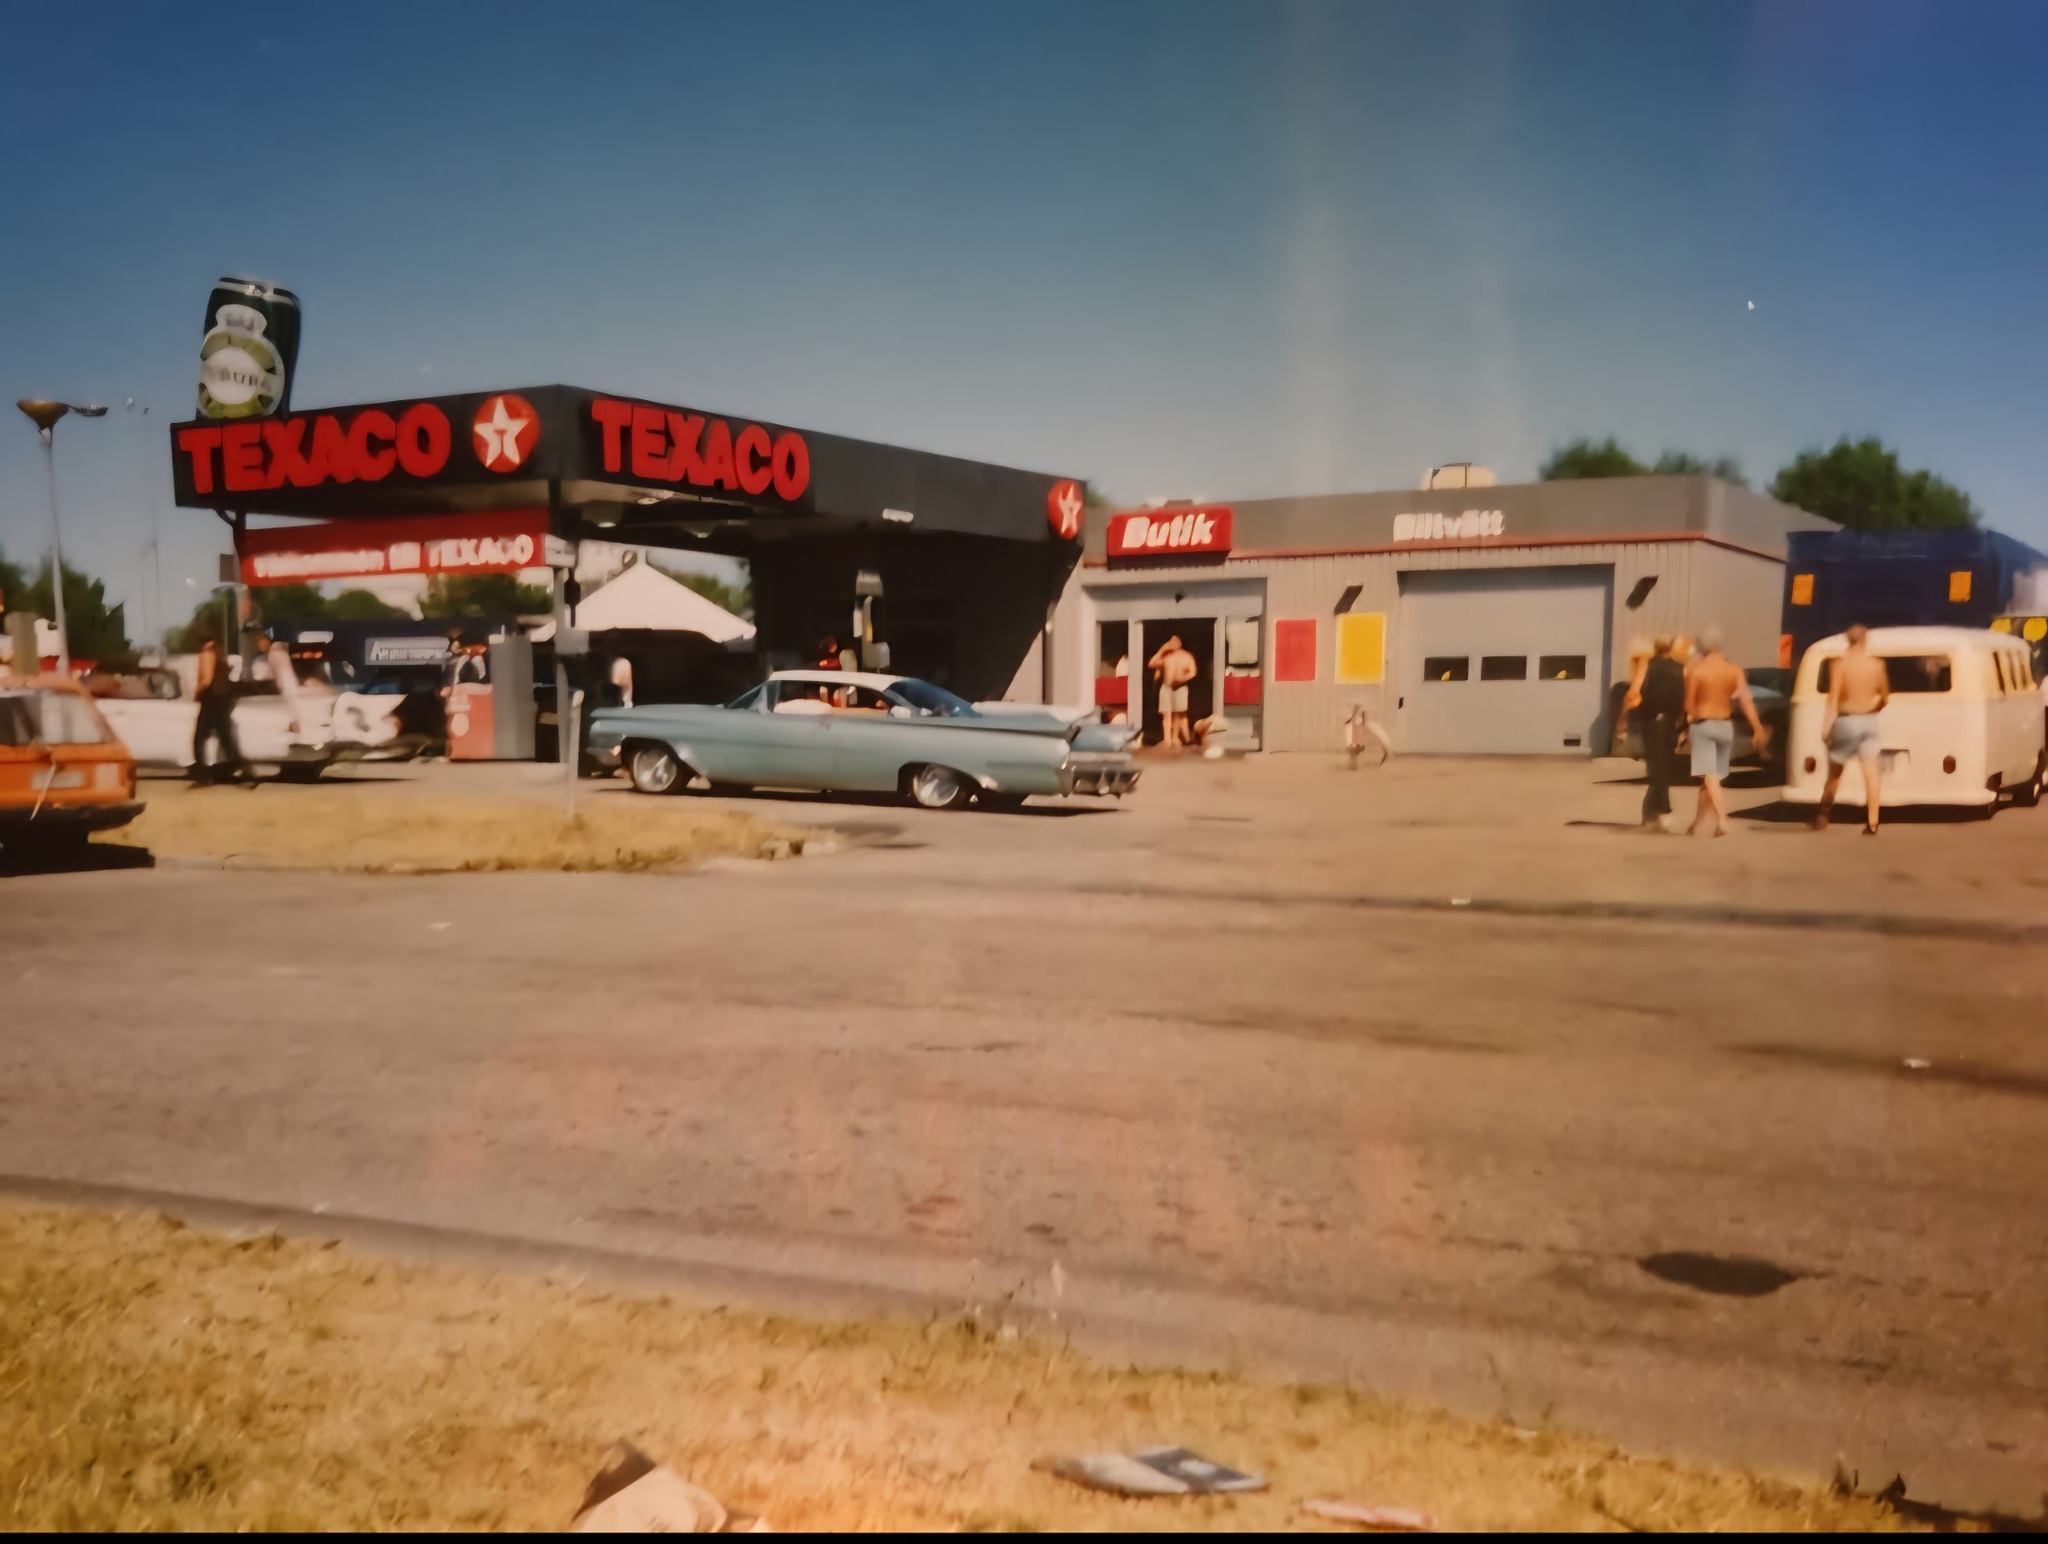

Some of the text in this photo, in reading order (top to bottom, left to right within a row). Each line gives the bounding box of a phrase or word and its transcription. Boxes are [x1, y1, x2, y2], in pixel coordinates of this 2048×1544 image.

[178, 402, 451, 494] TEXACO
[591, 399, 810, 501] TEXACO
[426, 534, 534, 568] TEXACO
[1122, 513, 1216, 548] Butik
